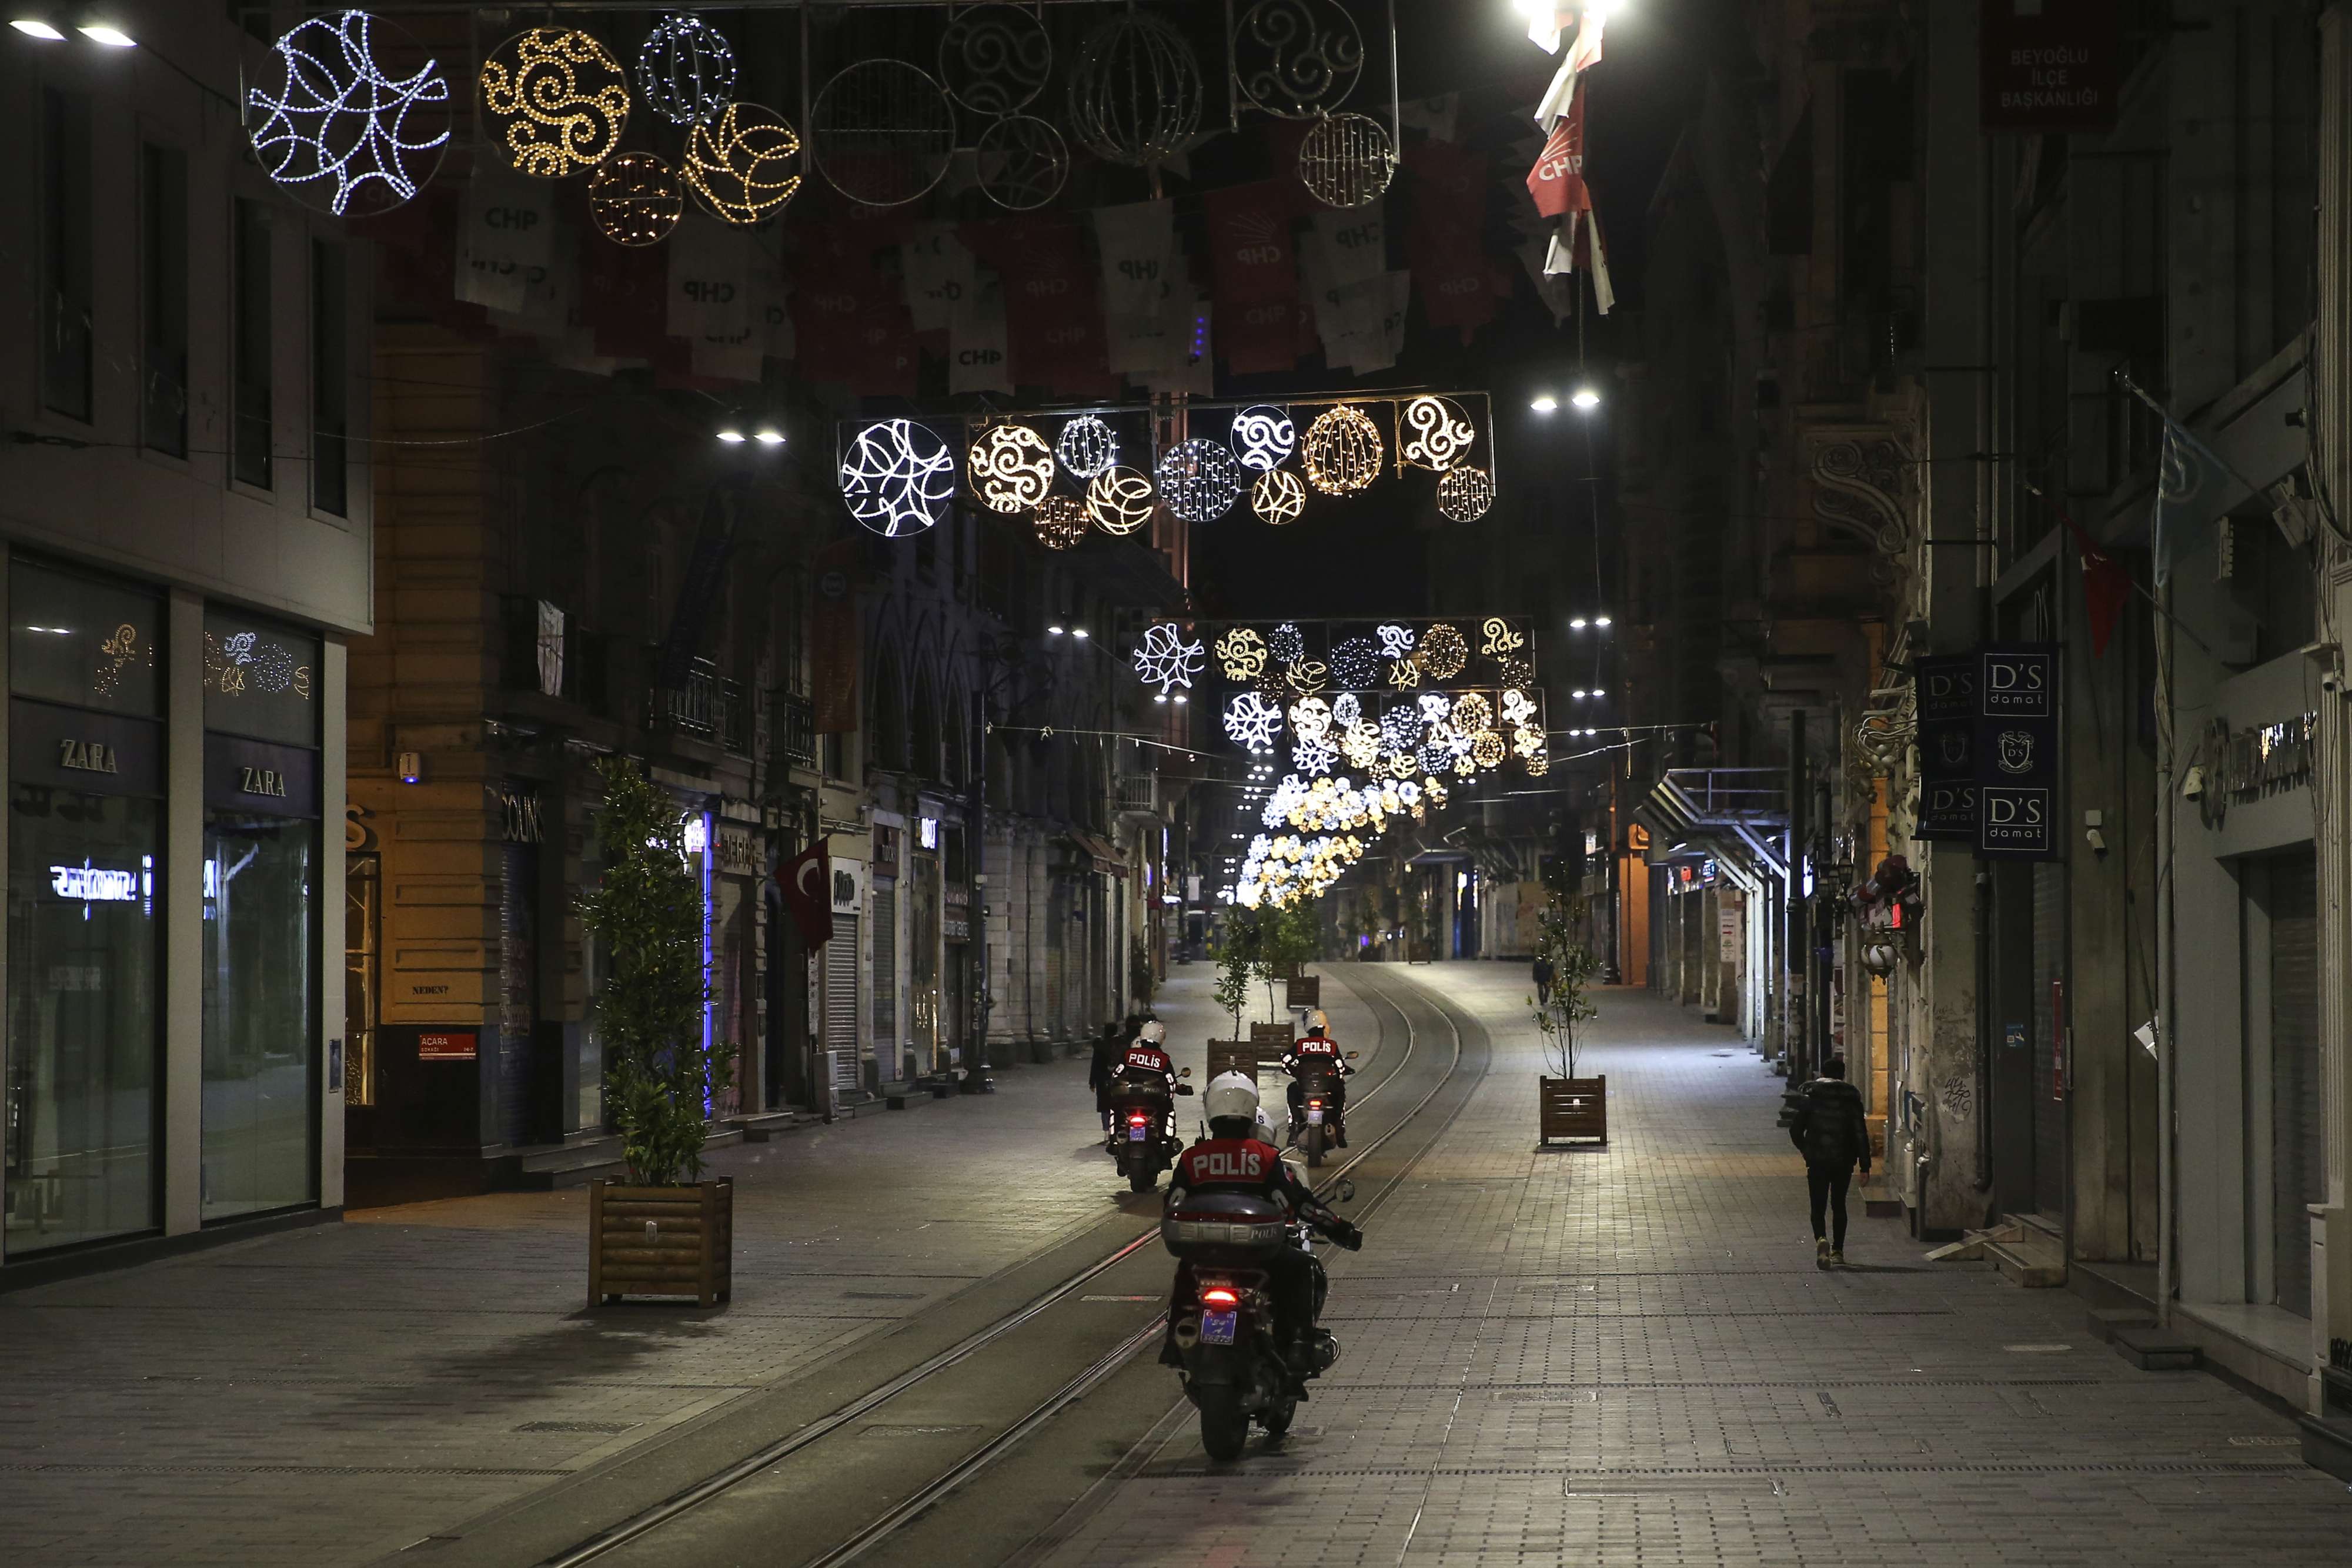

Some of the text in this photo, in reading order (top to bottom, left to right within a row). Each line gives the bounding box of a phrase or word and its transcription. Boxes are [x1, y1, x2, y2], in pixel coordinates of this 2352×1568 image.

[2011, 45, 2089, 66] BEYOĞLU
[2032, 67, 2069, 88] İLÇE
[2001, 86, 2098, 111] BAŞKANLIĞI
[1539, 155, 1582, 180] CHP
[486, 208, 539, 230] CHP
[959, 349, 1003, 365] CHP
[1991, 663, 2042, 689] D'S
[1990, 693, 2042, 704] damat
[60, 739, 118, 774] ZARA
[2008, 748, 2023, 757] D'S
[240, 767, 287, 797] ZARA
[1989, 798, 2041, 824] D'S
[1990, 828, 2042, 838] damat
[412, 986, 449, 995] NEDEN?
[421, 1037, 448, 1046] ACARA
[1302, 1040, 1332, 1054] POLİS
[1129, 1053, 1161, 1068] POLİS
[1193, 1148, 1261, 1179] POLİS
